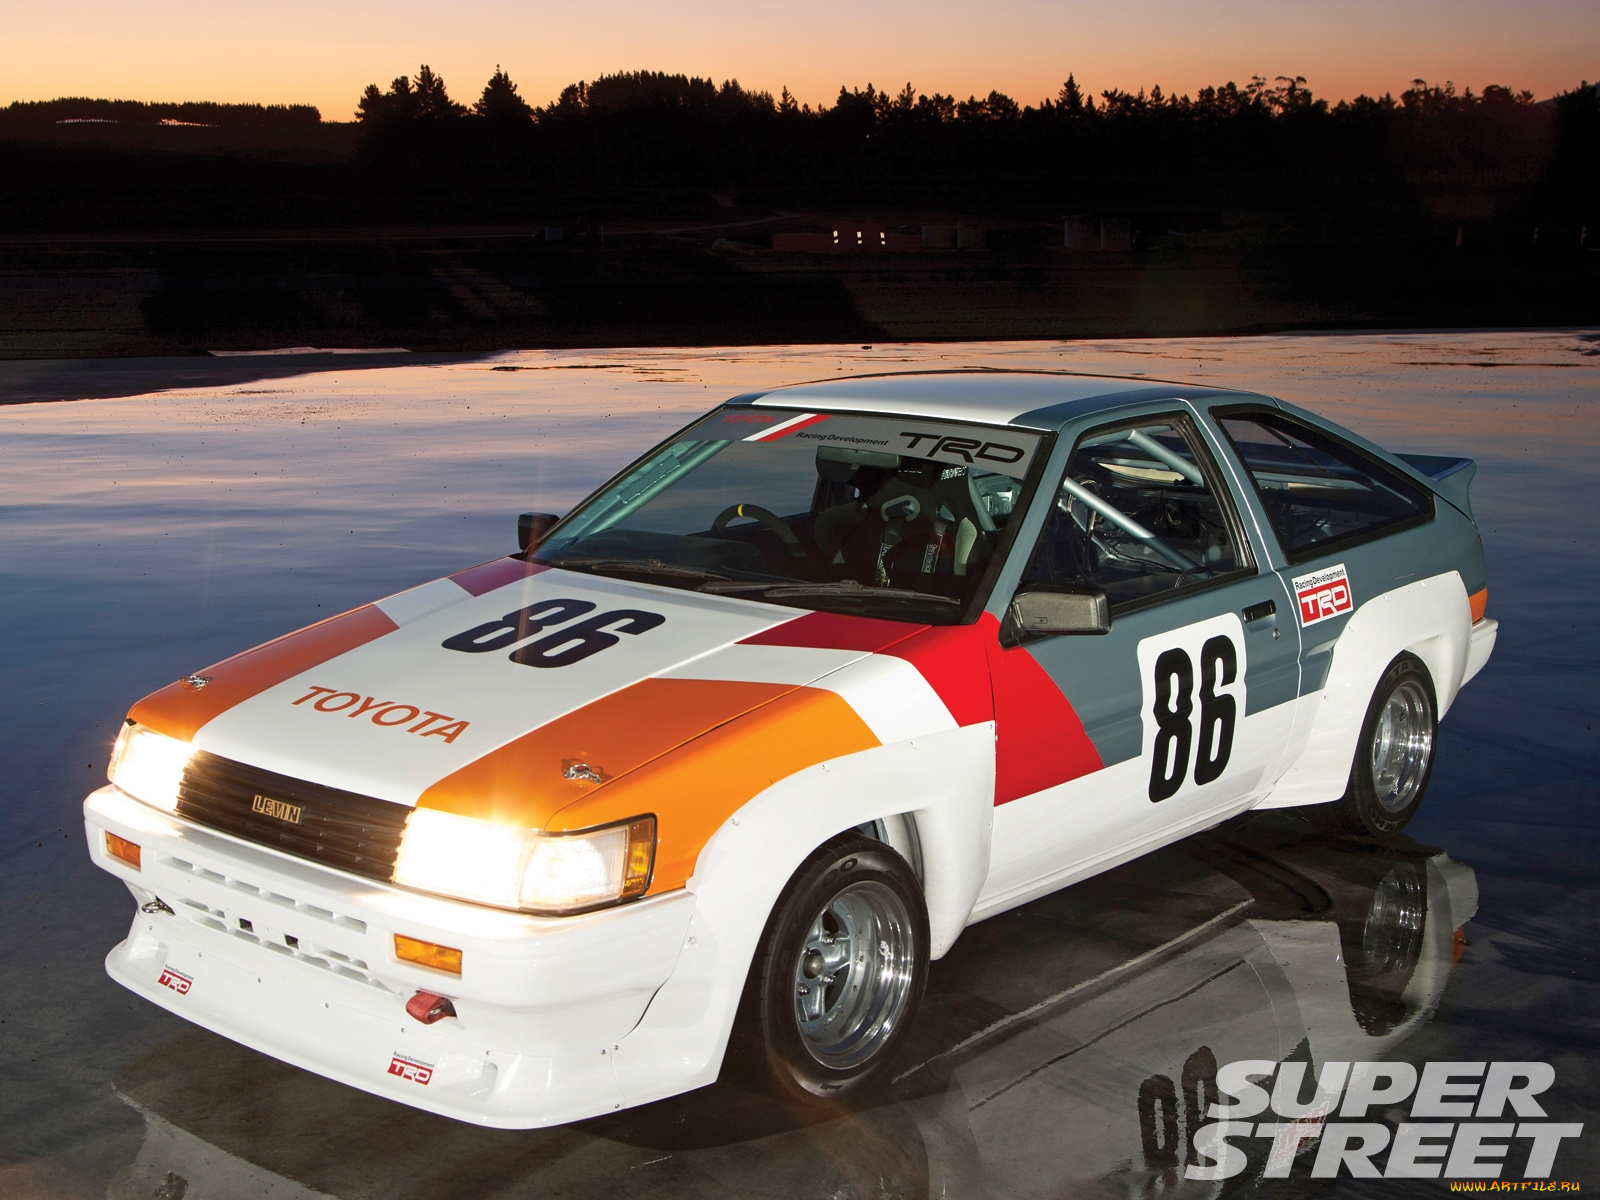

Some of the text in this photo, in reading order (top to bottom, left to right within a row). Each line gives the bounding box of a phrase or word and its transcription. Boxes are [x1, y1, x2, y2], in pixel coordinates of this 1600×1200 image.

[721, 415, 775, 425] TOYOTA
[796, 432, 889, 446] Racing Development
[899, 432, 1025, 463] TRD
[1295, 569, 1345, 590] Racing Development
[1300, 585, 1348, 617] TRD
[442, 599, 666, 668] 86
[291, 686, 470, 744] TOYOTA
[1149, 635, 1237, 803] 86
[252, 795, 301, 824] LEVIN
[162, 971, 190, 992] TRD
[391, 1060, 430, 1082] TRD
